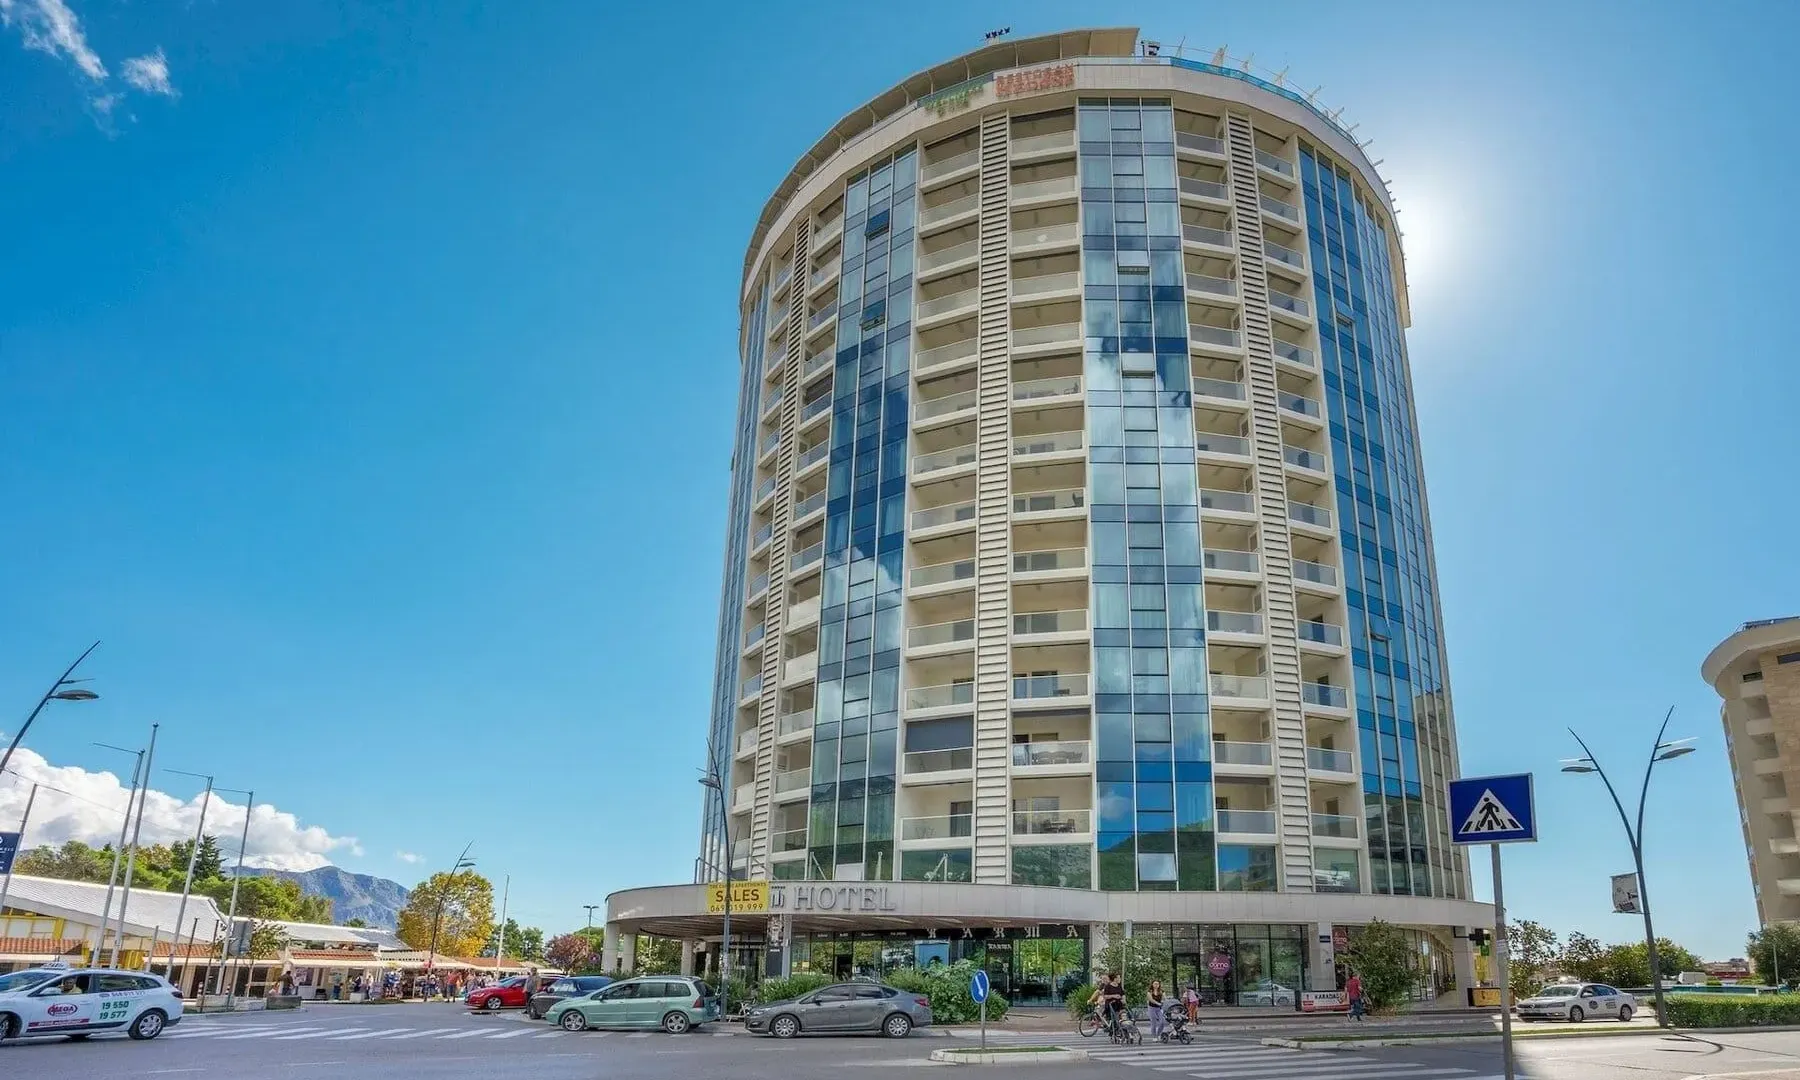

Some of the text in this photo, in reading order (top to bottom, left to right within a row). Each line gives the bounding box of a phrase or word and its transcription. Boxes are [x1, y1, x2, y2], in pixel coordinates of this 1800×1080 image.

[715, 888, 760, 902] SALES
[793, 886, 896, 912] HOTEL
[102, 1000, 130, 1010] 19 550
[99, 1010, 127, 1020] 19 577
